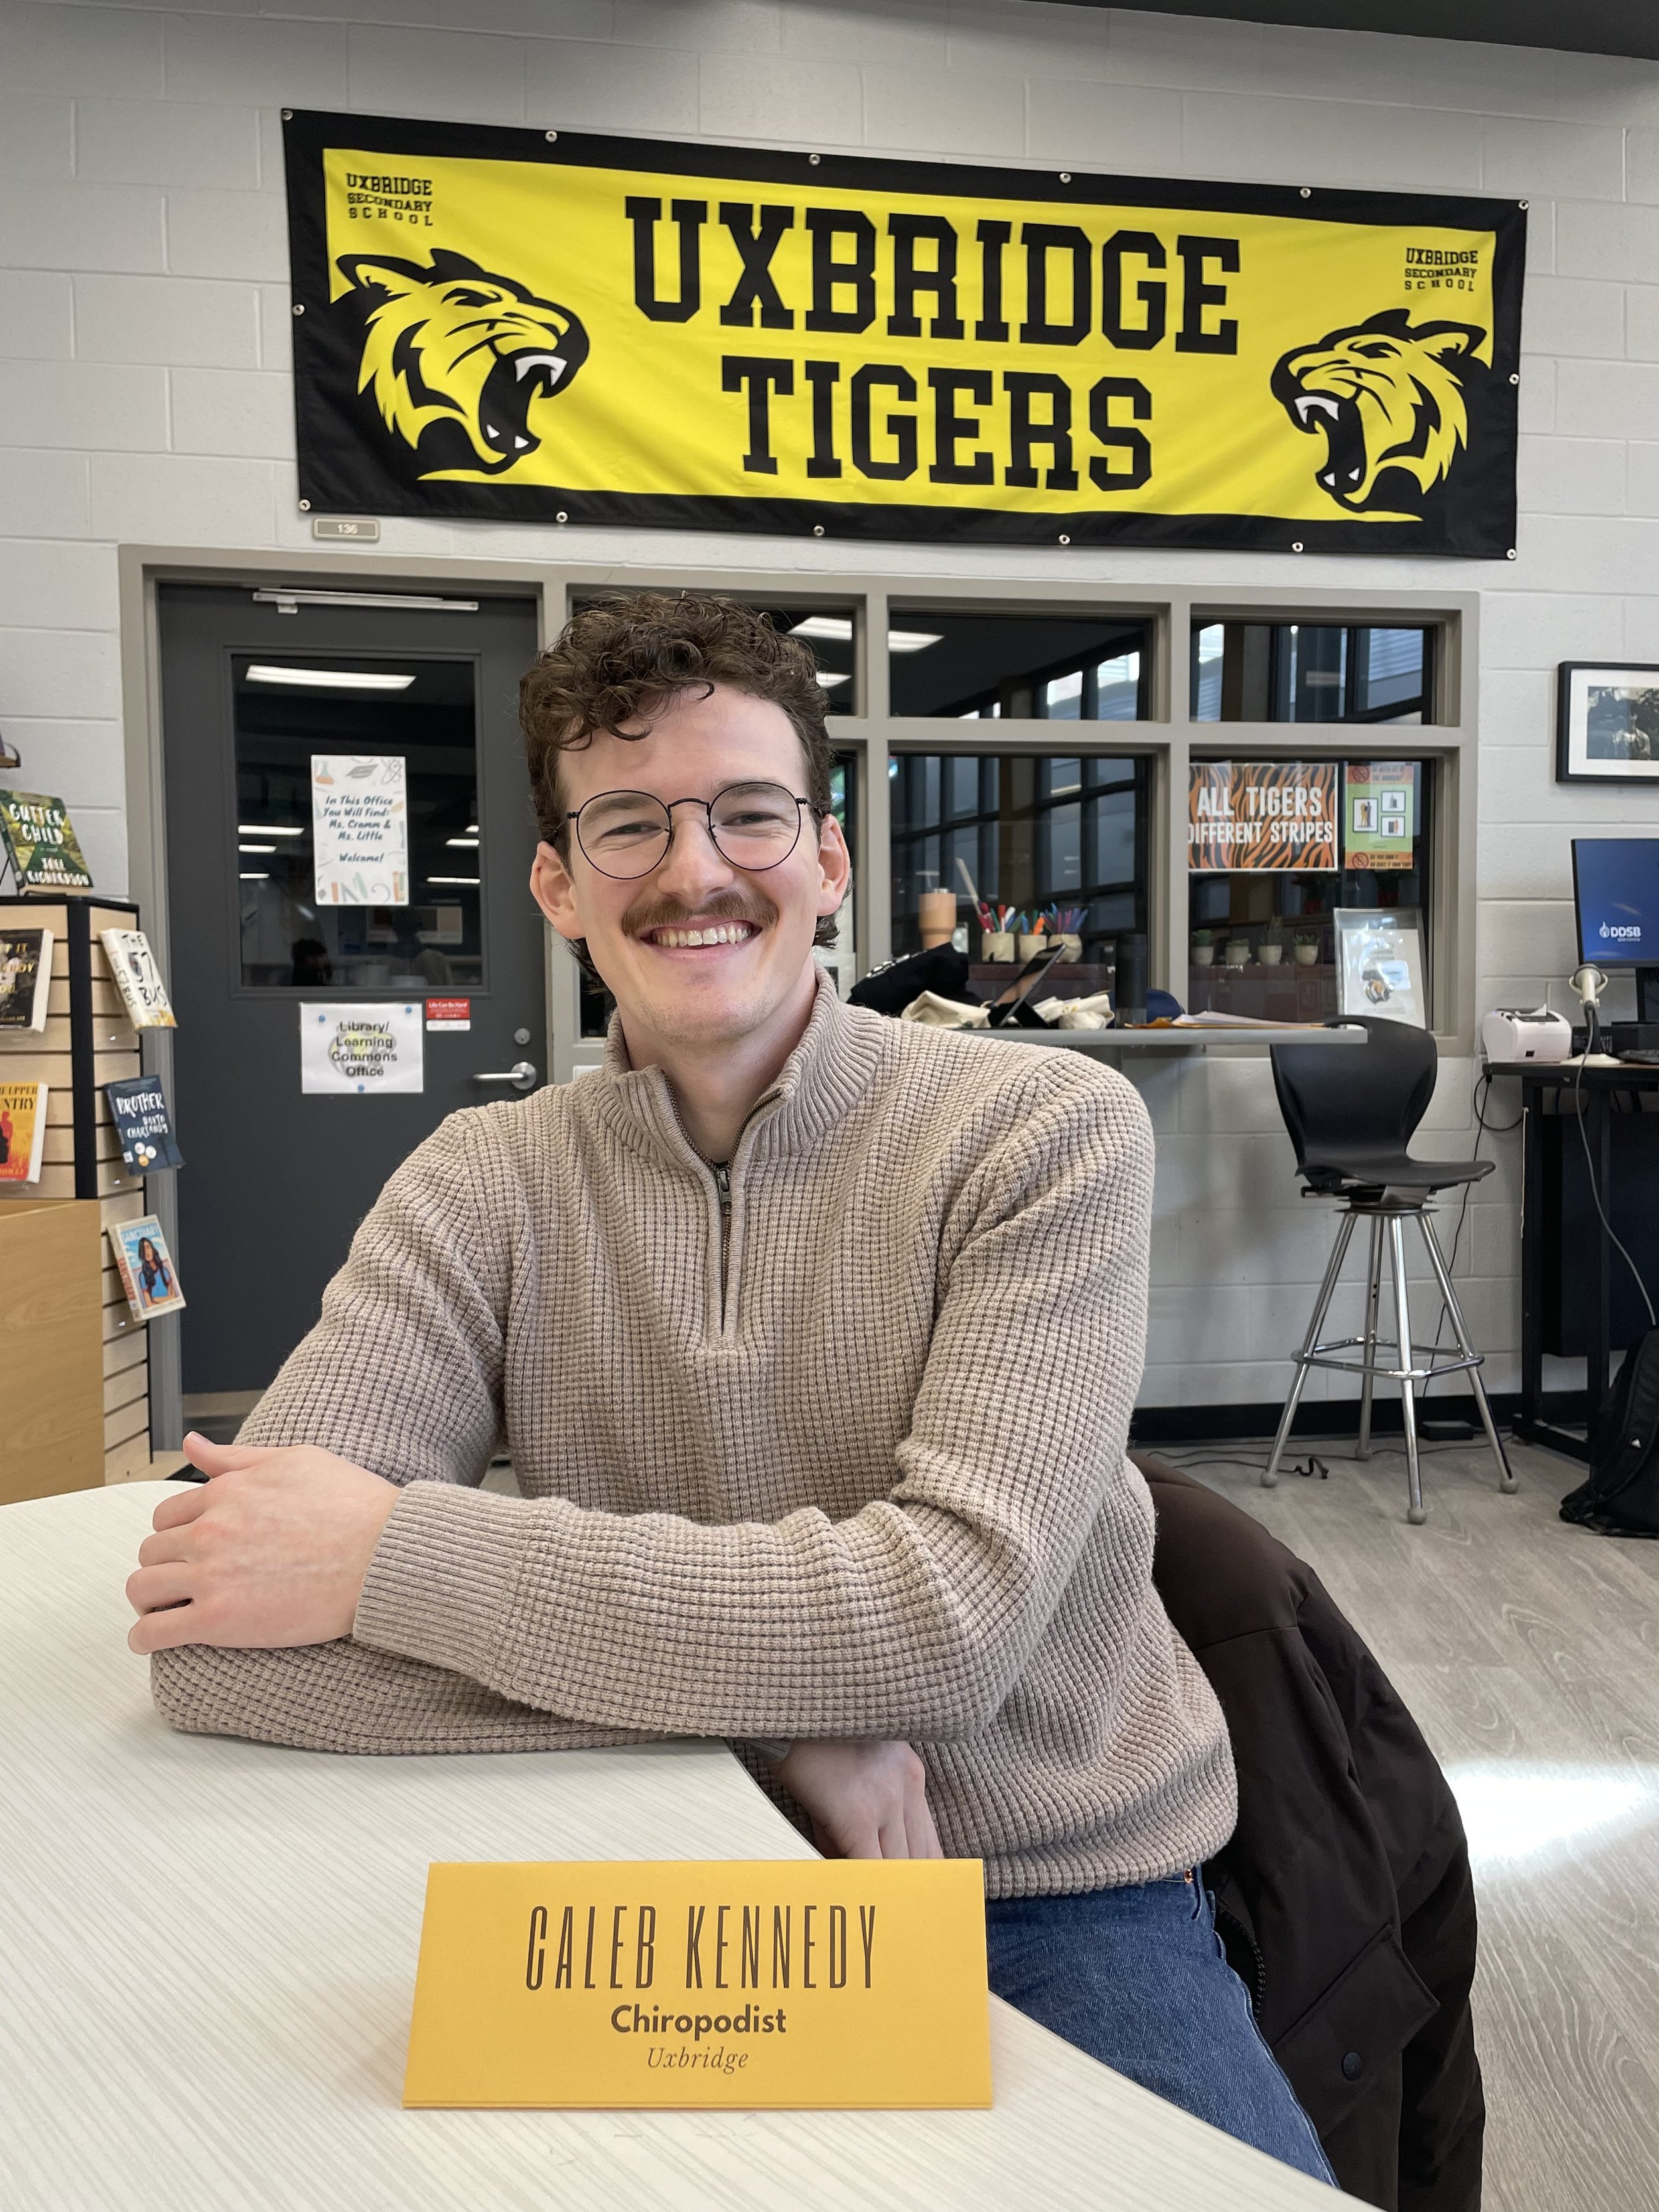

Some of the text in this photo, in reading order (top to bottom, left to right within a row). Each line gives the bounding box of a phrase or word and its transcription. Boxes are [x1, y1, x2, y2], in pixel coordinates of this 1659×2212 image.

[346, 173, 433, 196] UXBRIDGE
[346, 192, 433, 212] SECONDARY
[348, 207, 433, 226] SCHOOL
[1406, 247, 1479, 265] UXBRIDGE
[624, 195, 1241, 356] UXBRIDGE
[1404, 267, 1477, 278] SECONDARY
[1404, 278, 1475, 292] SCHOOL
[721, 355, 1153, 492] TIGERS
[325, 794, 394, 805] In This Office
[1197, 786, 1323, 816] ALL TIGERS
[9, 803, 64, 827] GUTTER
[323, 806, 341, 817] You
[344, 806, 364, 816] Will
[384, 818, 392, 829] &
[1270, 821, 1333, 844] STRIPES
[21, 823, 64, 846] CHILD
[356, 830, 383, 840] Little
[339, 852, 385, 863] Welcome!
[122, 934, 144, 948] THE
[1610, 926, 1642, 938] DDSB
[128, 950, 155, 983] 57
[138, 984, 168, 1007] BUS
[339, 1021, 390, 1033] Library/
[336, 1035, 393, 1049] Learning
[332, 1051, 398, 1062] Commons
[345, 1065, 384, 1077] Office
[0, 1098, 36, 1110] NTRY
[115, 1092, 165, 1118] BROTHER
[526, 1905, 877, 1992] CALEB KENNEDY
[610, 2003, 787, 2042] Chiropodist
[647, 2045, 749, 2075] Uxbridge
